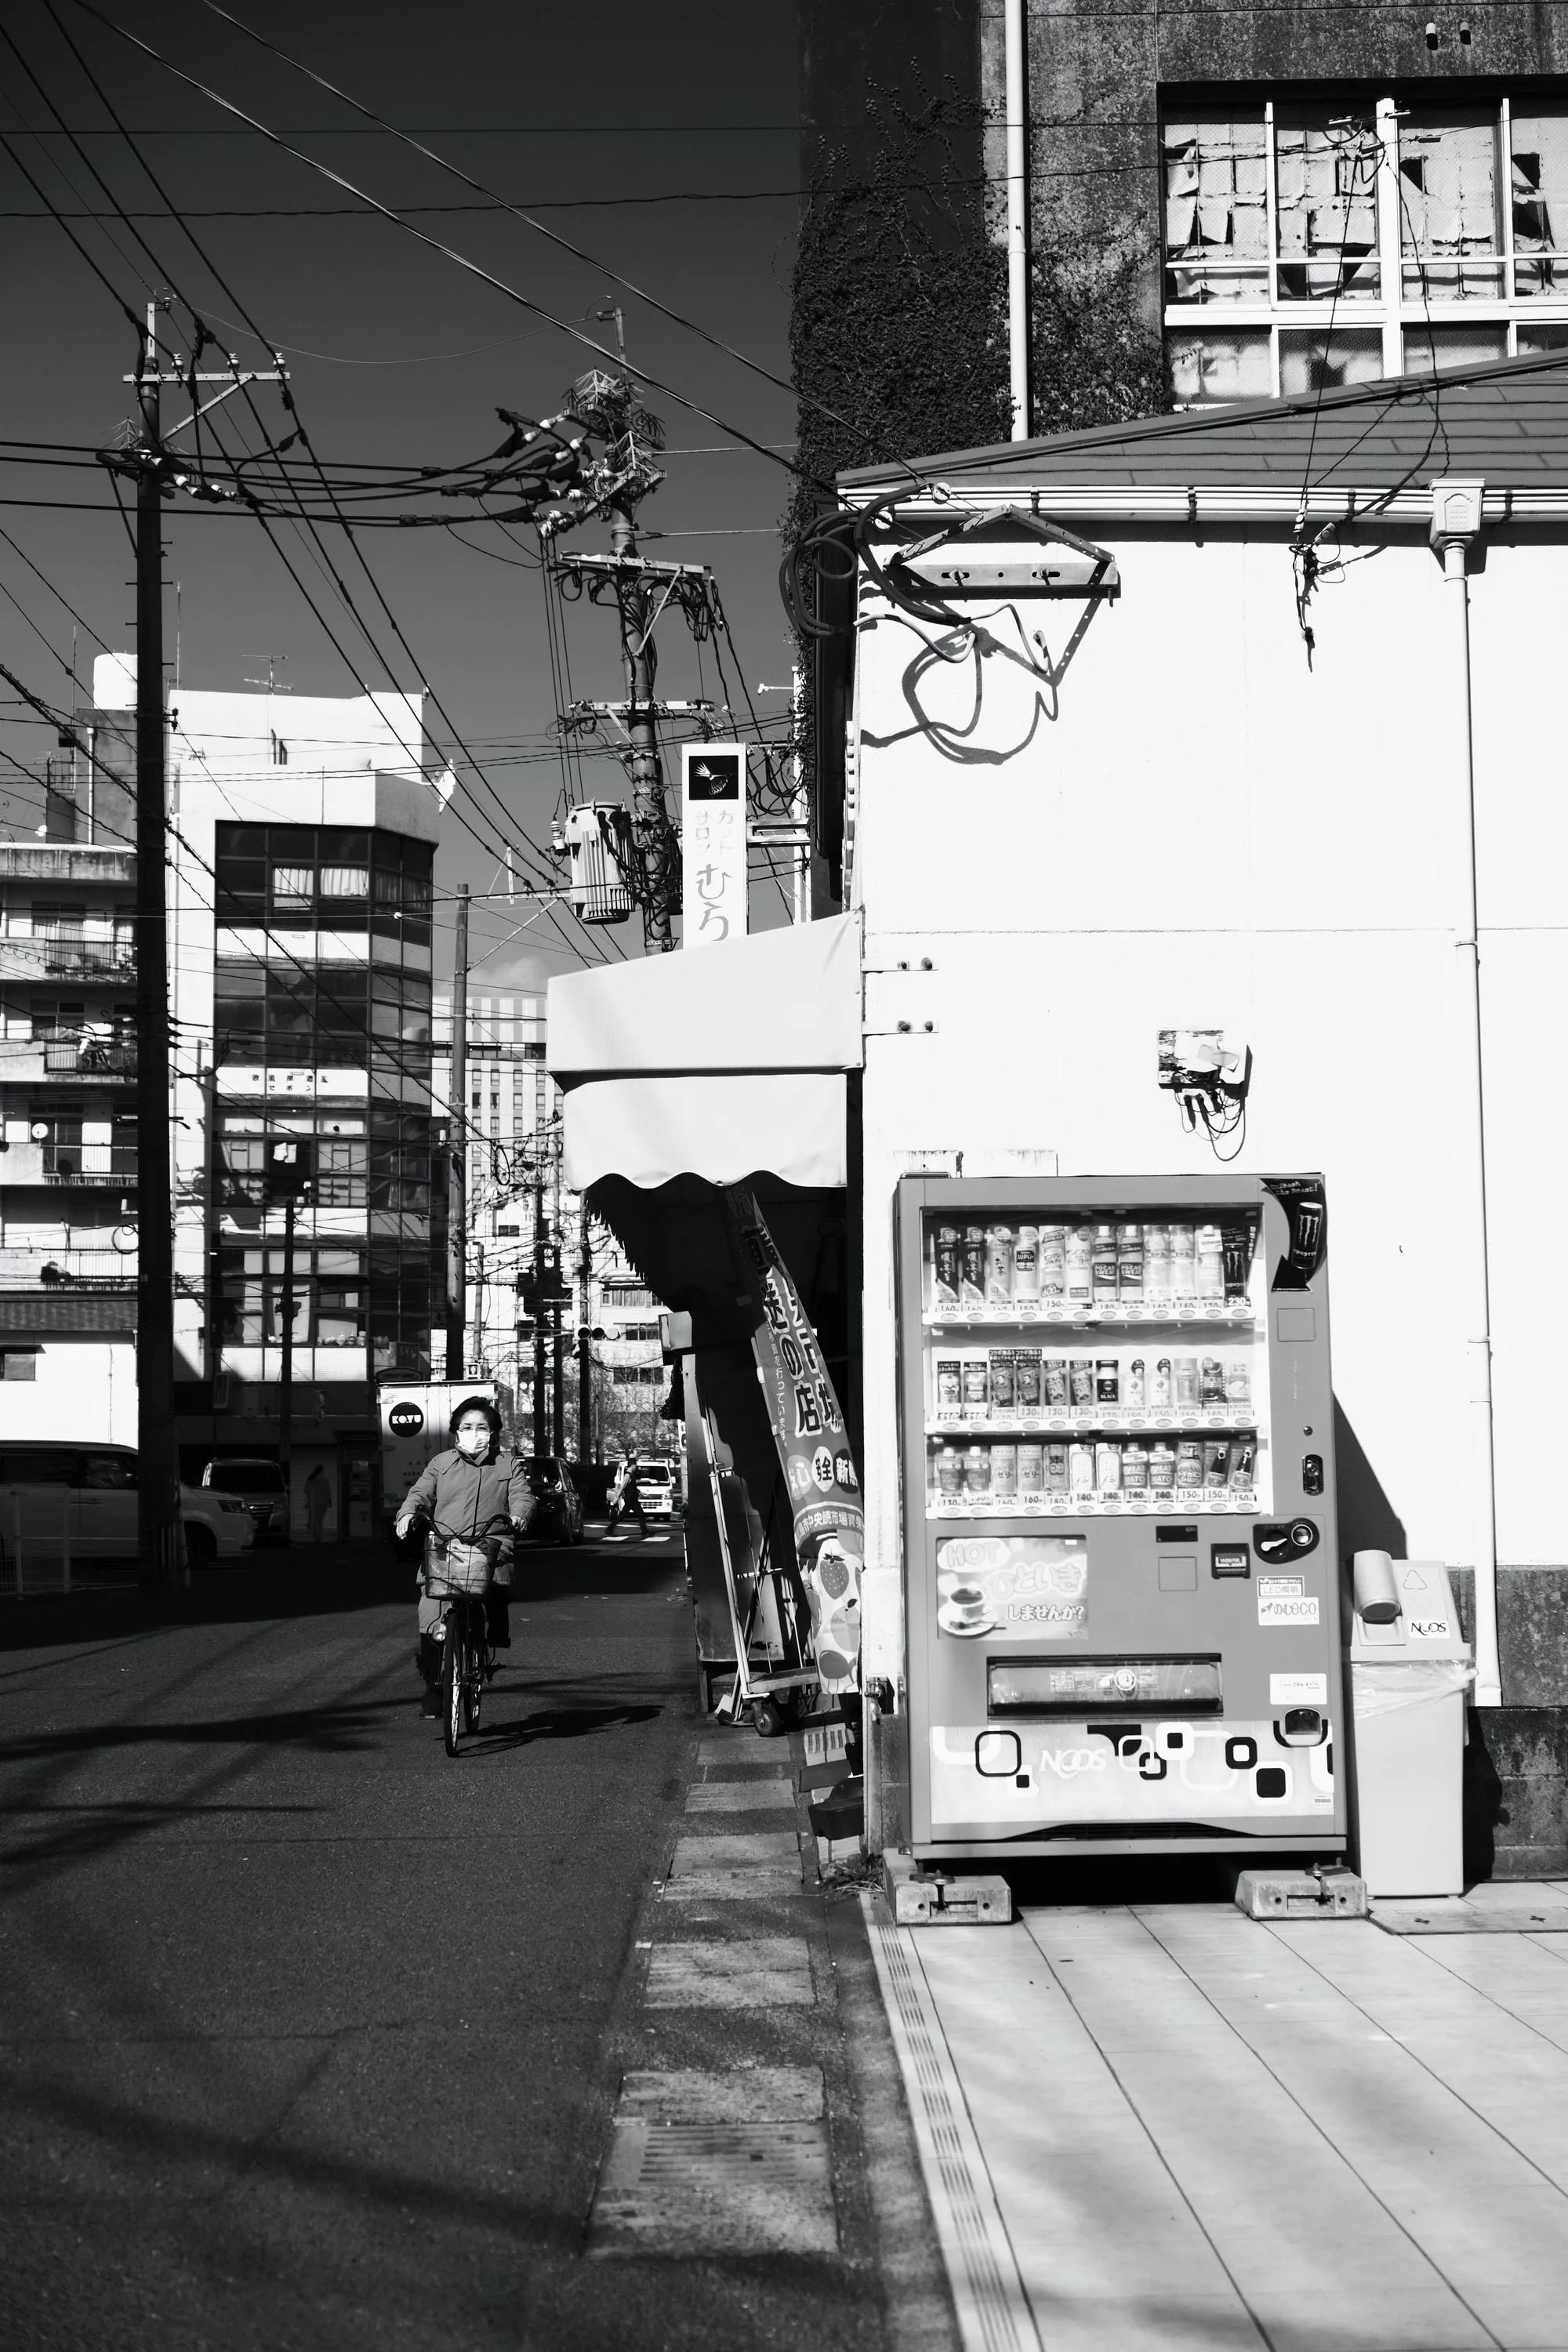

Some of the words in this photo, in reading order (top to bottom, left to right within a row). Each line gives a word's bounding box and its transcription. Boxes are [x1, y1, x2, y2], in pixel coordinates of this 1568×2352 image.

[946, 1541, 1000, 1567] HOT
[987, 1563, 1083, 1601] ひといき
[1007, 1603, 1086, 1622] しませんか?
